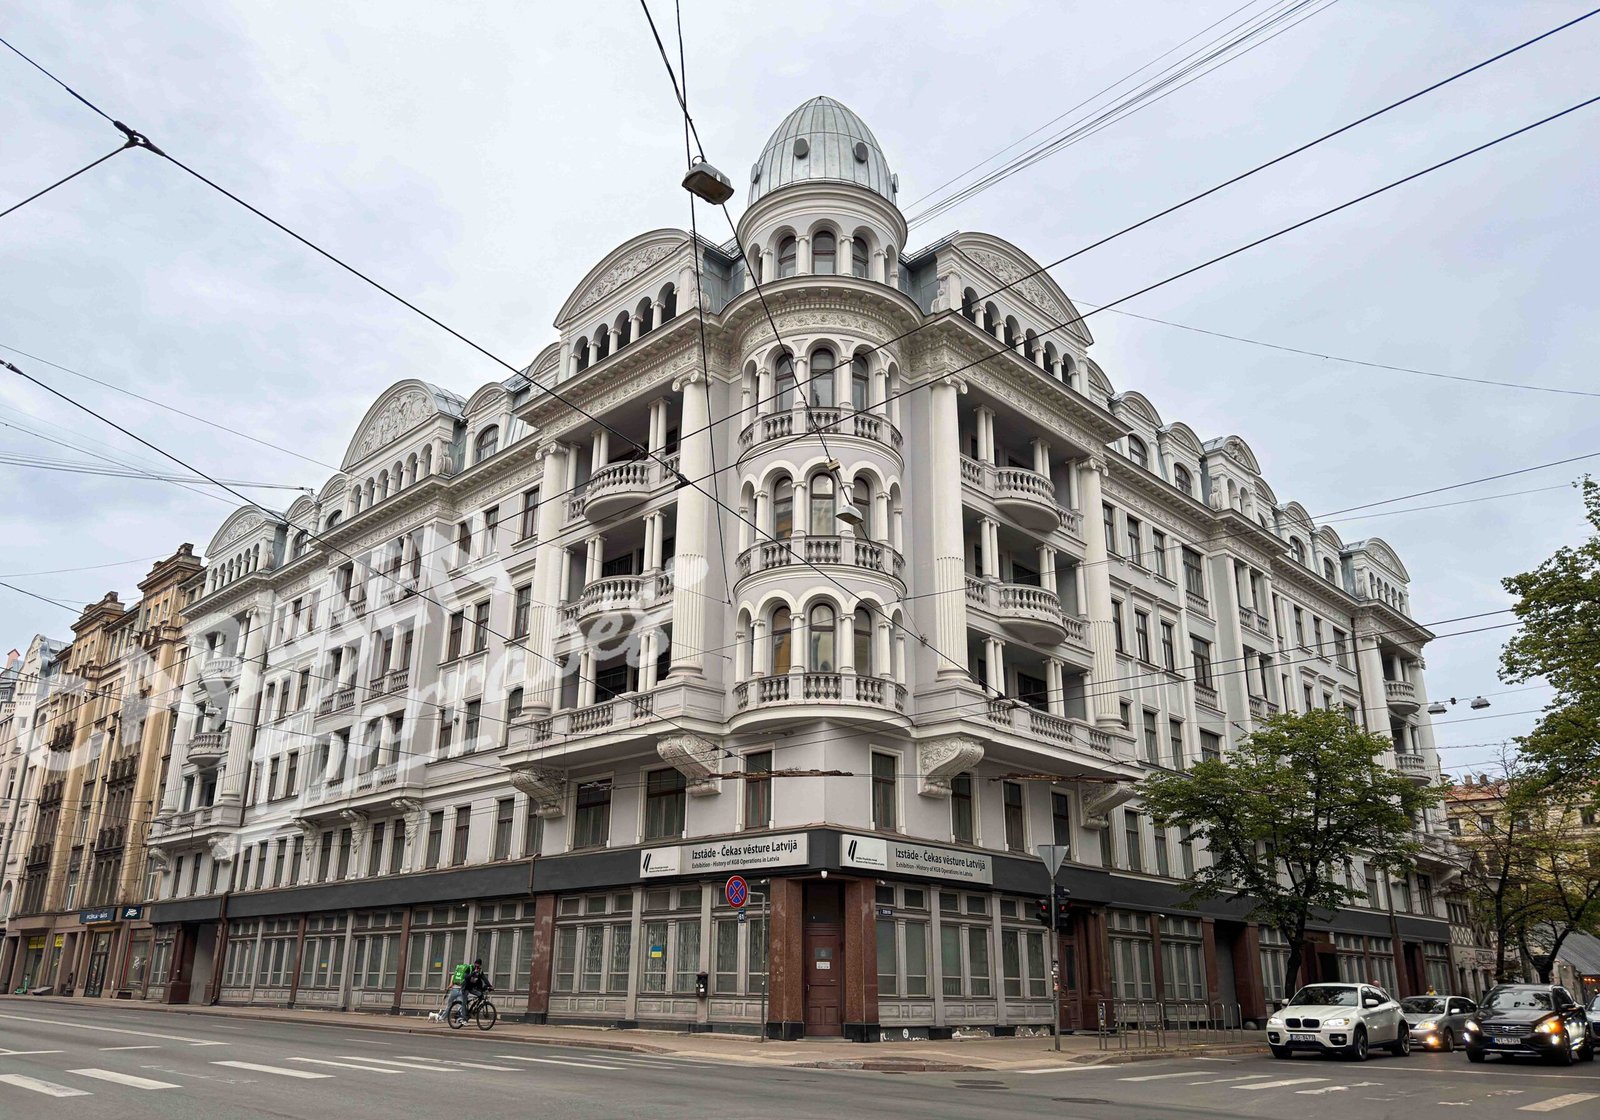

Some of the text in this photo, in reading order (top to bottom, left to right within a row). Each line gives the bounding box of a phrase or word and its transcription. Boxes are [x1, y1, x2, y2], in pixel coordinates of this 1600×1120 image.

[692, 848, 717, 860] Izstāde
[721, 844, 742, 857] Čekas
[743, 843, 771, 856] vēsture
[771, 839, 798, 854] Latvijā
[691, 860, 711, 869] Exhibition
[712, 860, 727, 868] History
[740, 857, 762, 866] Operations
[766, 855, 780, 863] Latvia
[895, 847, 919, 860] Izstāde
[923, 850, 942, 863] Čekas
[942, 854, 966, 867] vēsture
[965, 856, 986, 872] Latvijā
[916, 864, 929, 873] History
